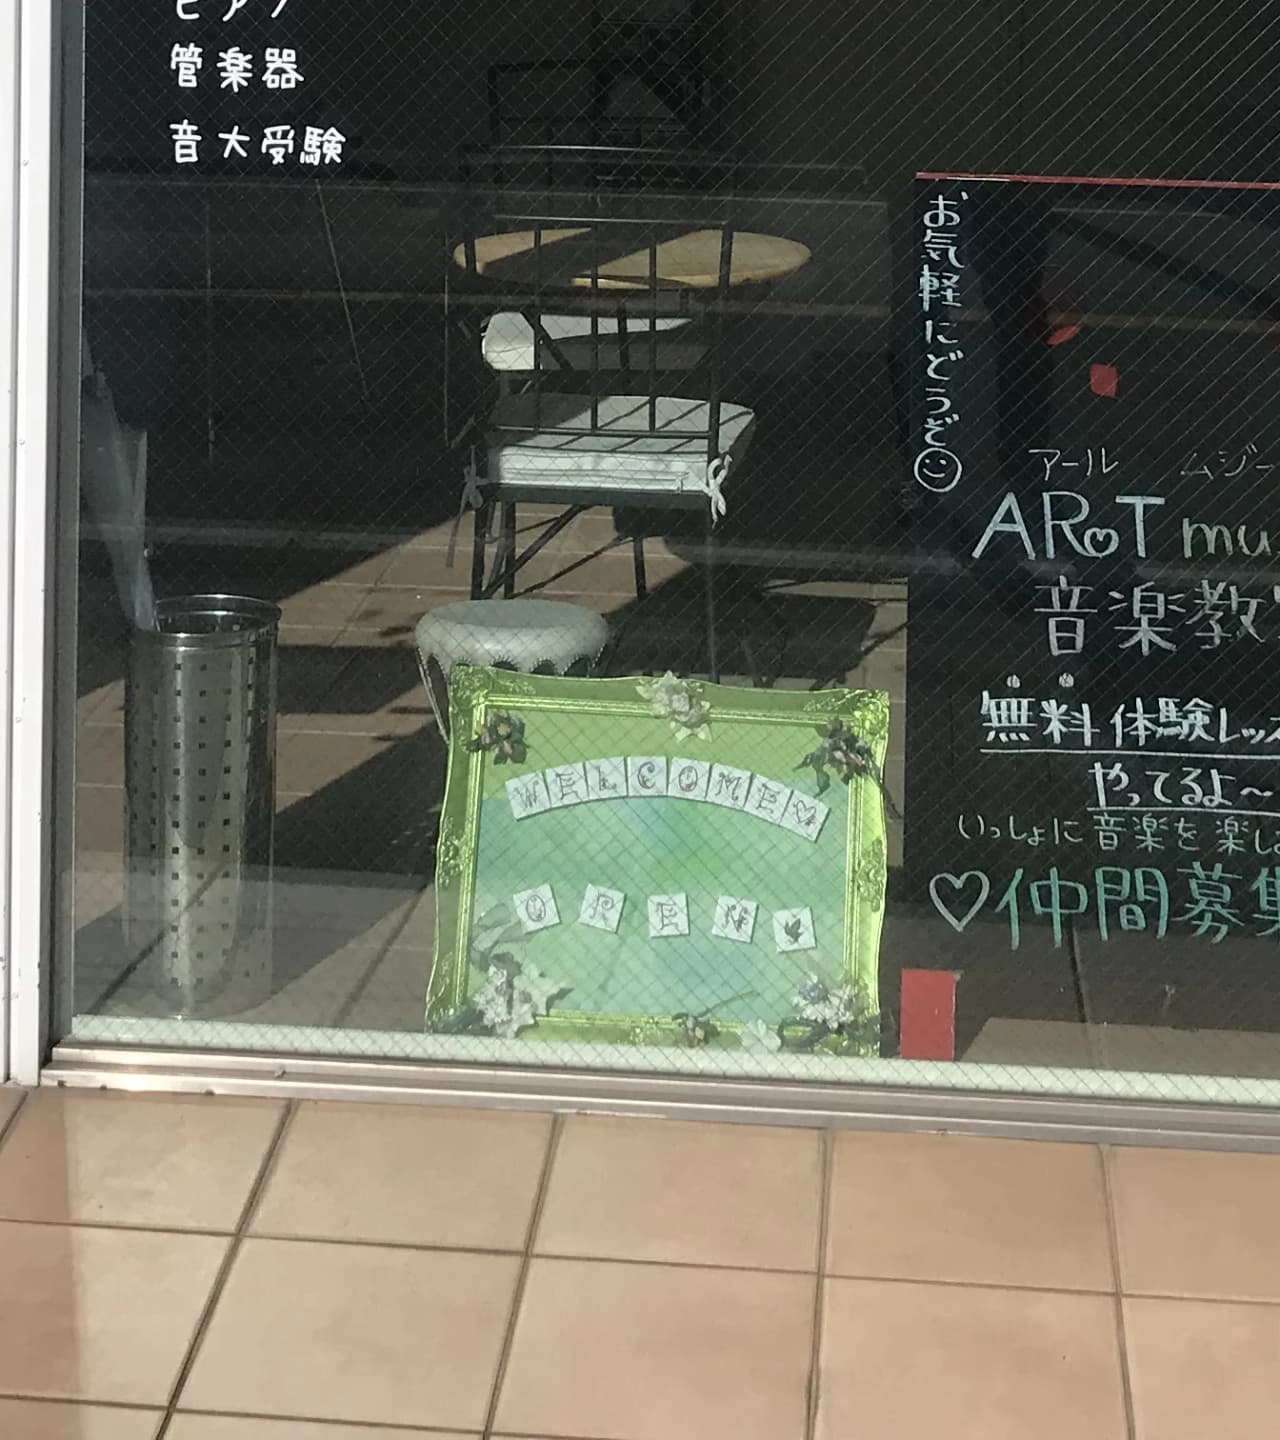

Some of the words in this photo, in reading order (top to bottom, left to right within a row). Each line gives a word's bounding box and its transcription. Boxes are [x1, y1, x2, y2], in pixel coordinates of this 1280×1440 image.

[170, 42, 305, 93] 管楽器
[169, 119, 347, 166] 音大受験
[918, 191, 969, 447] お気軽にどうぞ
[517, 760, 782, 811] WELCOME
